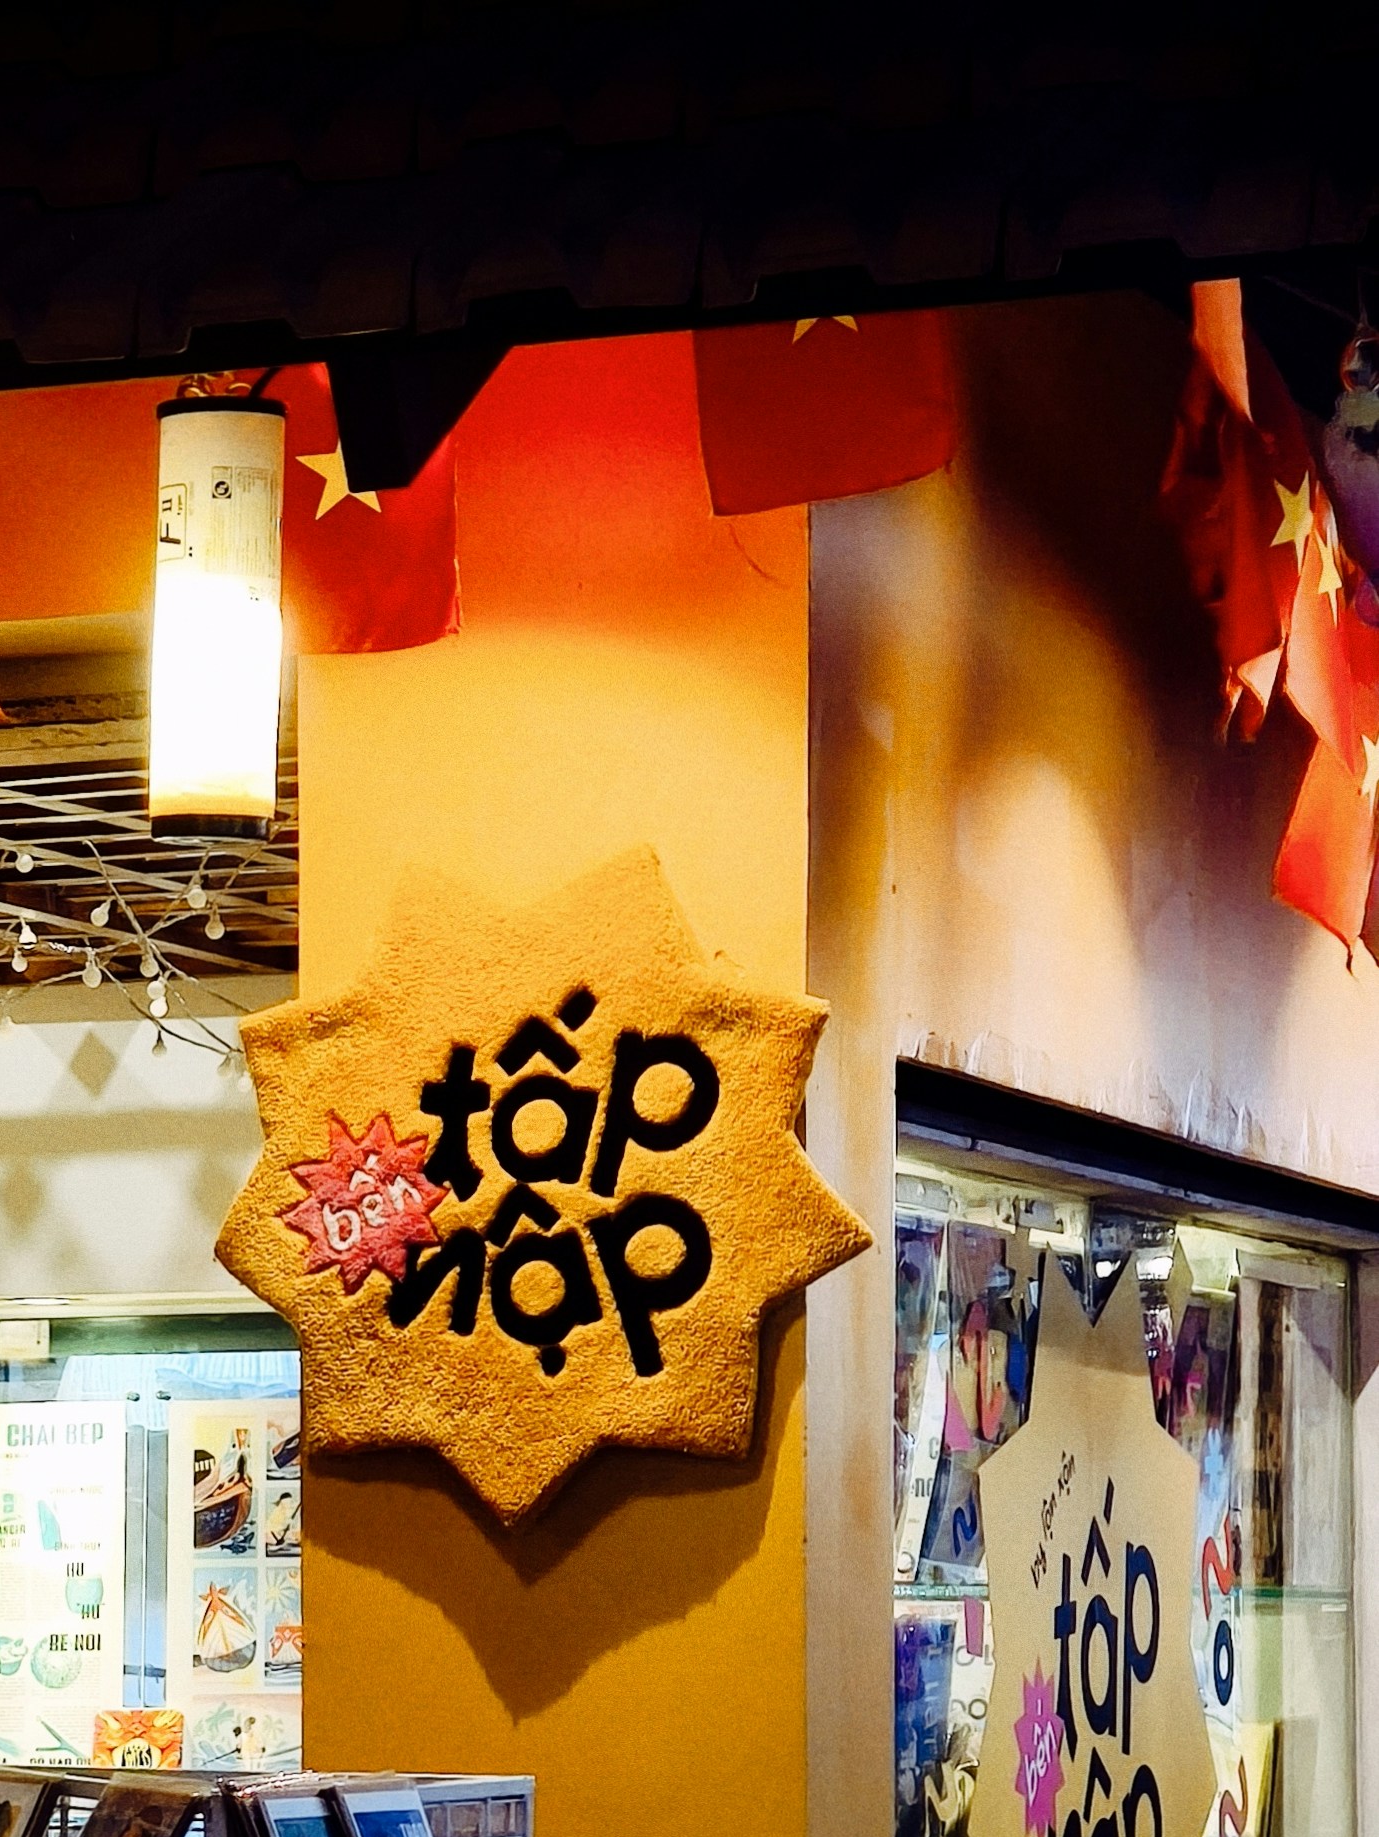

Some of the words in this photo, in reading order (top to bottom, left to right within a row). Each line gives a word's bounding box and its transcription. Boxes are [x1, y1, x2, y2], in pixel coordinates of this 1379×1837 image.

[420, 986, 720, 1201] tấp
[322, 1153, 422, 1251] bến
[386, 1184, 712, 1377] nập
[1054, 1477, 1160, 1761] tấp
[1024, 1699, 1057, 1807] bến
